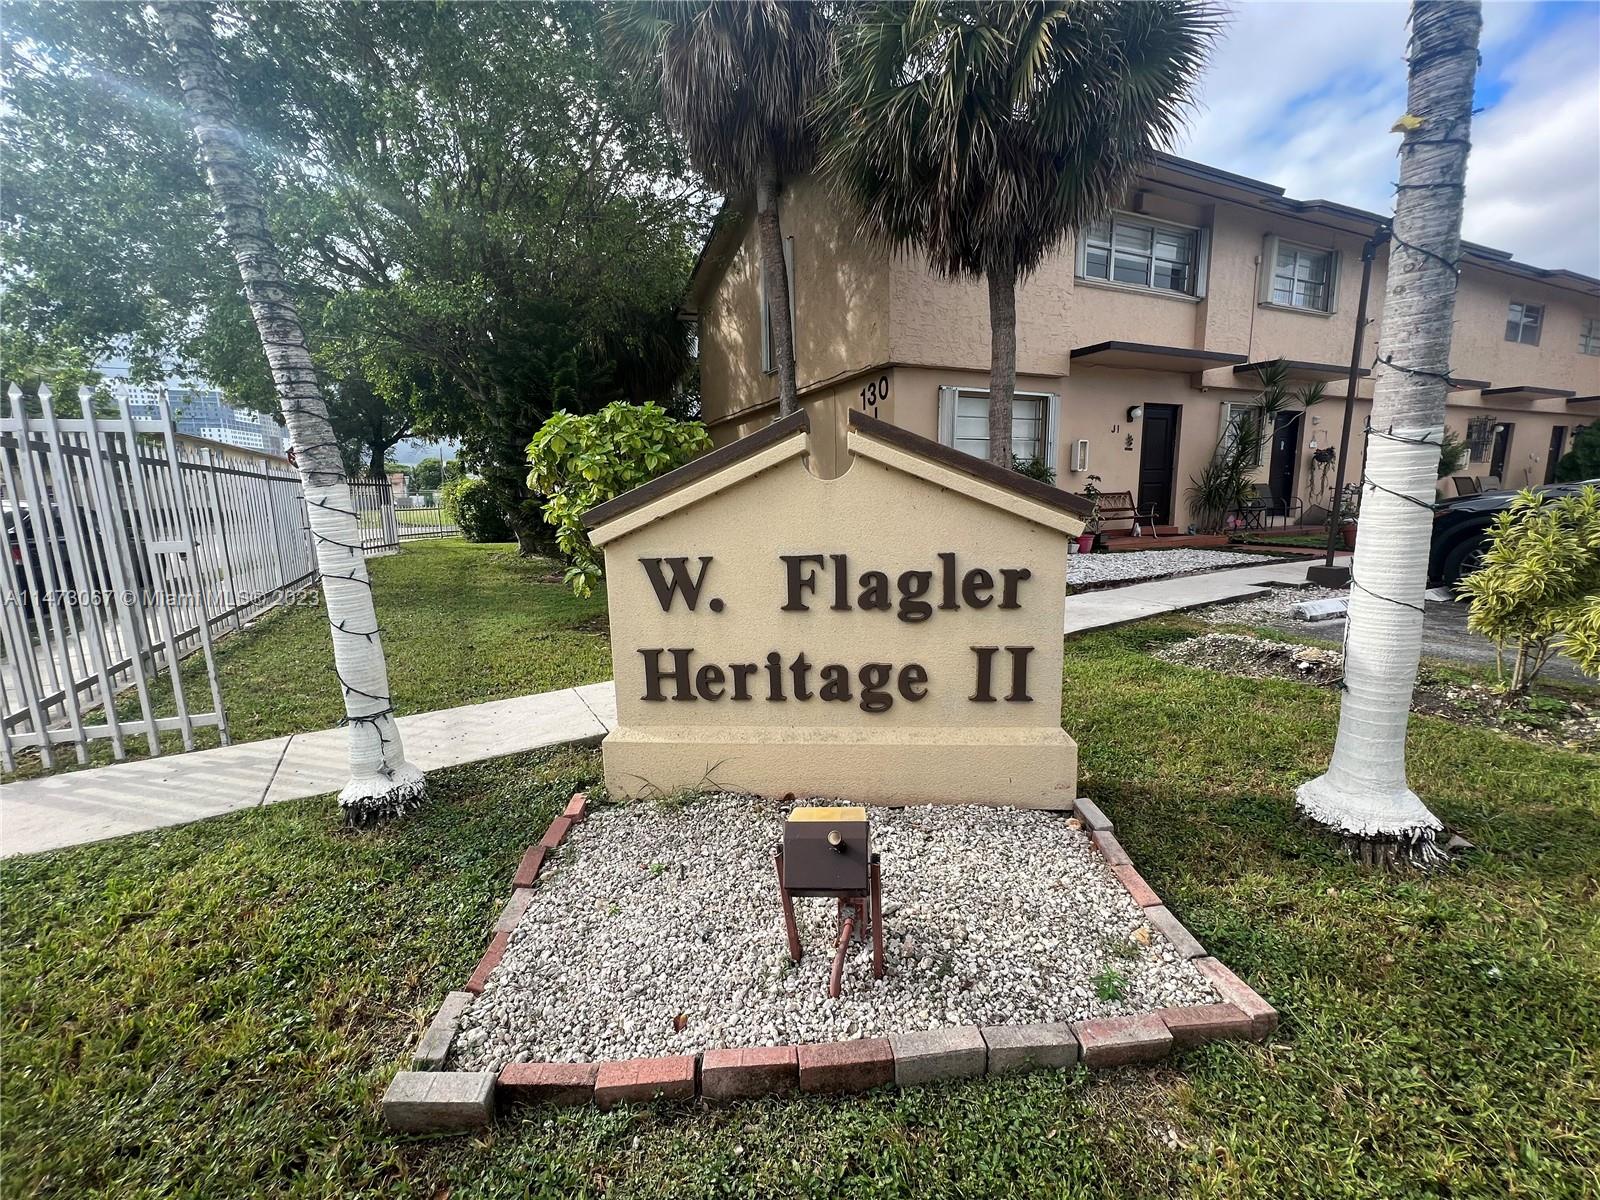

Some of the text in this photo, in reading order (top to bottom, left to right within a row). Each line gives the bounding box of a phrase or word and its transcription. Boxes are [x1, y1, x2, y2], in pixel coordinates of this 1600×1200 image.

[860, 375, 889, 411] 130
[638, 552, 1032, 623] W. Flagler
[636, 645, 1036, 714] Heritage II
